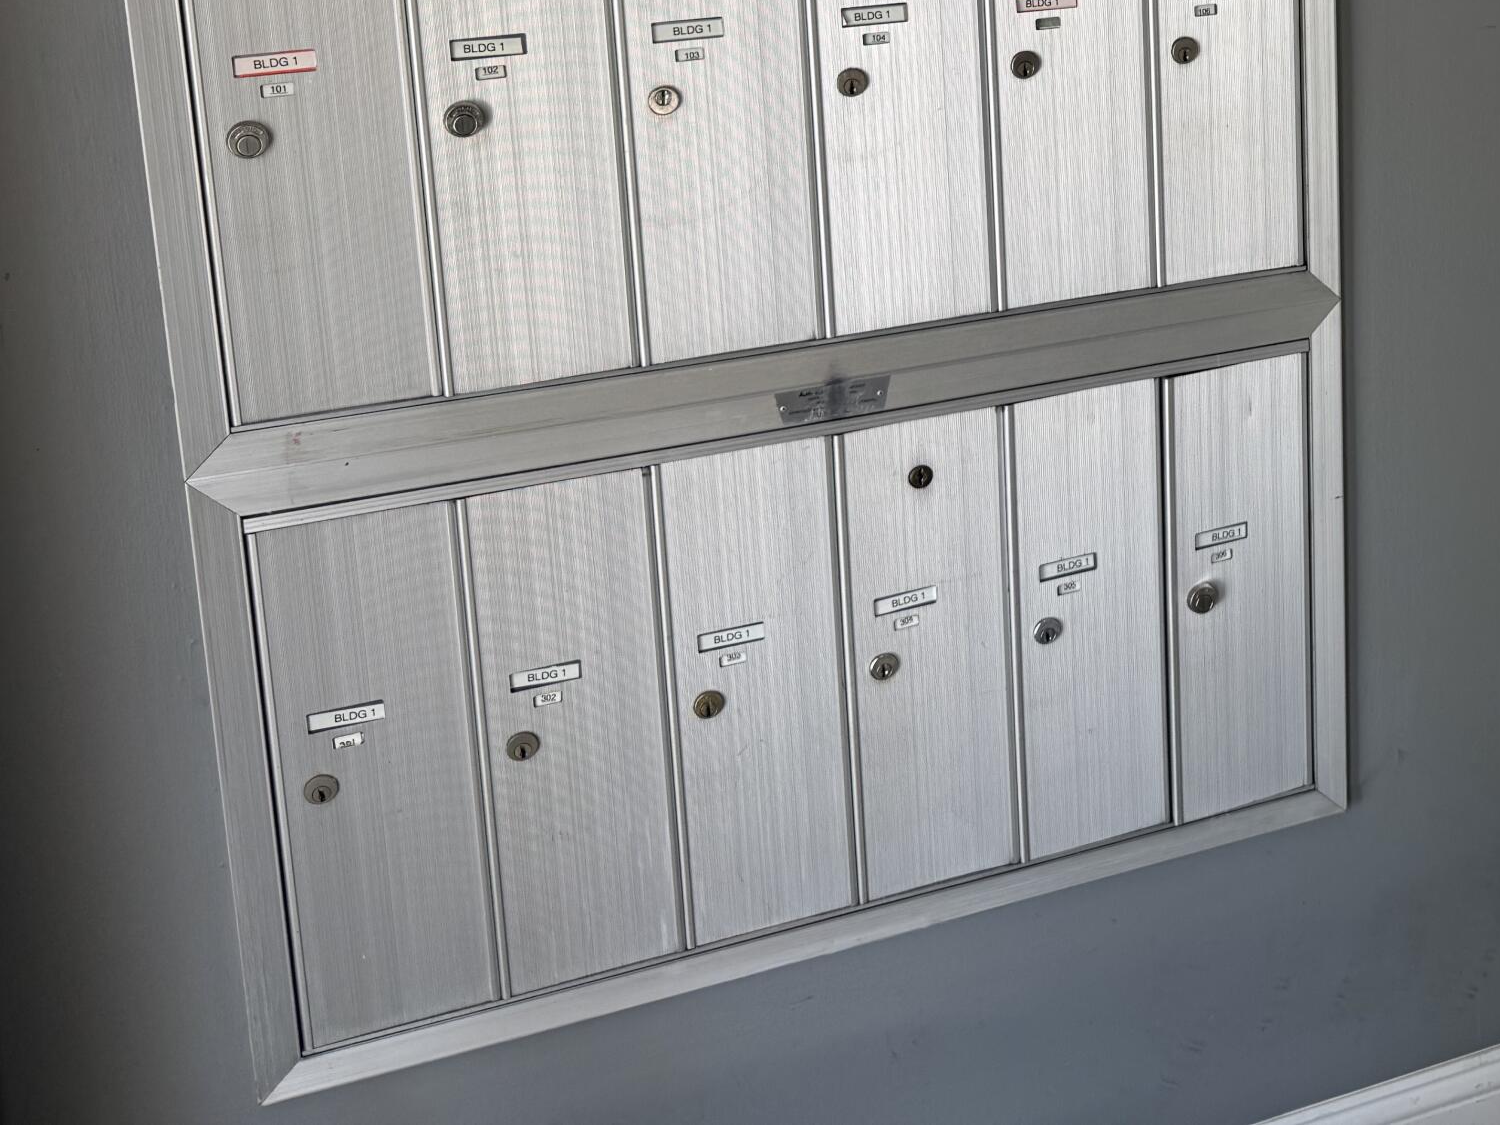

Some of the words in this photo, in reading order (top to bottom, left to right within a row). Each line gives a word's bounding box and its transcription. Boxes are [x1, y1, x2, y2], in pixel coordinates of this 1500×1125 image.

[854, 12, 883, 21] BLDG
[673, 25, 704, 35] BLDG
[872, 34, 885, 42] 104
[463, 43, 497, 53] BLDG
[254, 58, 289, 69] BLDG
[482, 66, 498, 74] 102
[270, 85, 287, 94] 101
[527, 671, 559, 682] BLDG
